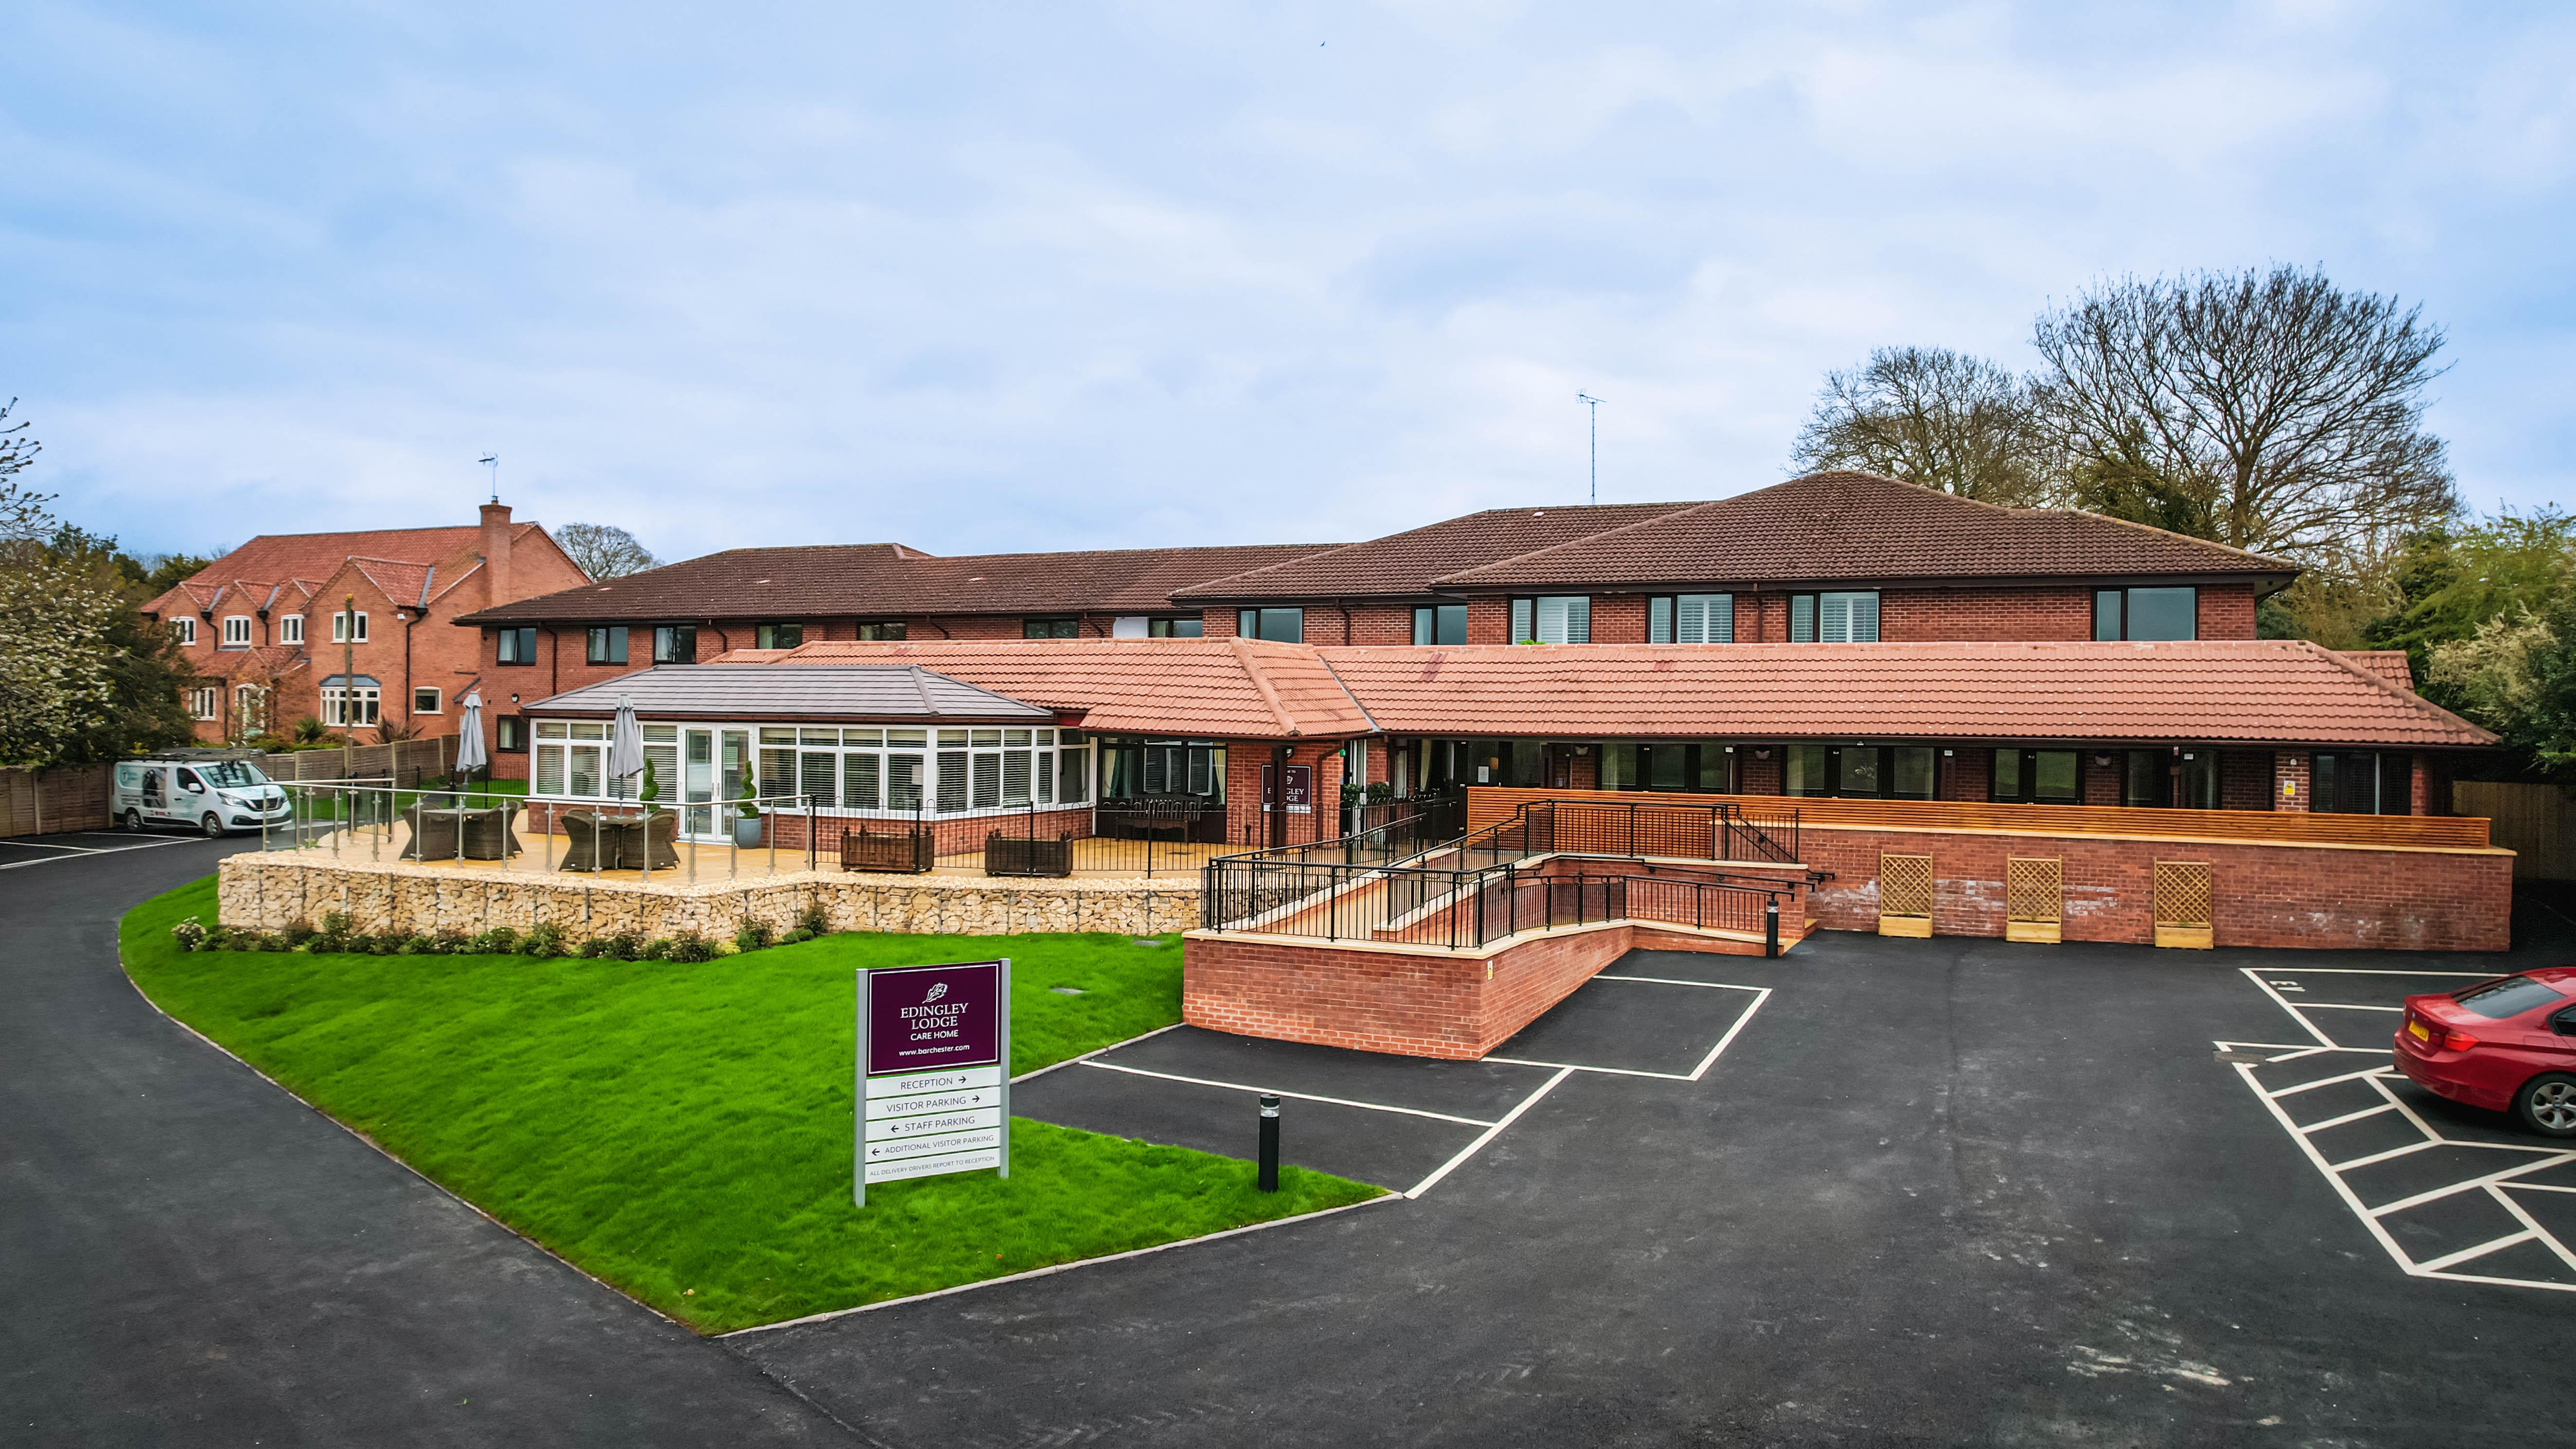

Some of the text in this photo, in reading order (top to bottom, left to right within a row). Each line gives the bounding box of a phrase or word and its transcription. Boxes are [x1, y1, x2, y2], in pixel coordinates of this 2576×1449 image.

[900, 1002, 969, 1018] EDINGLEY
[911, 1016, 958, 1030] LODGE
[910, 1030, 959, 1041] CARE HOME
[899, 1044, 970, 1056] www.barchester.com
[901, 1077, 953, 1090] RECEPTION
[886, 1096, 966, 1112] VISITOR PARKING
[904, 1116, 975, 1131] STAFF PARKING
[884, 1135, 994, 1154] ADDITIONAL VISITOR PARKING
[881, 1167, 908, 1175] DELIVERY
[965, 1156, 994, 1164] RECEPTION
